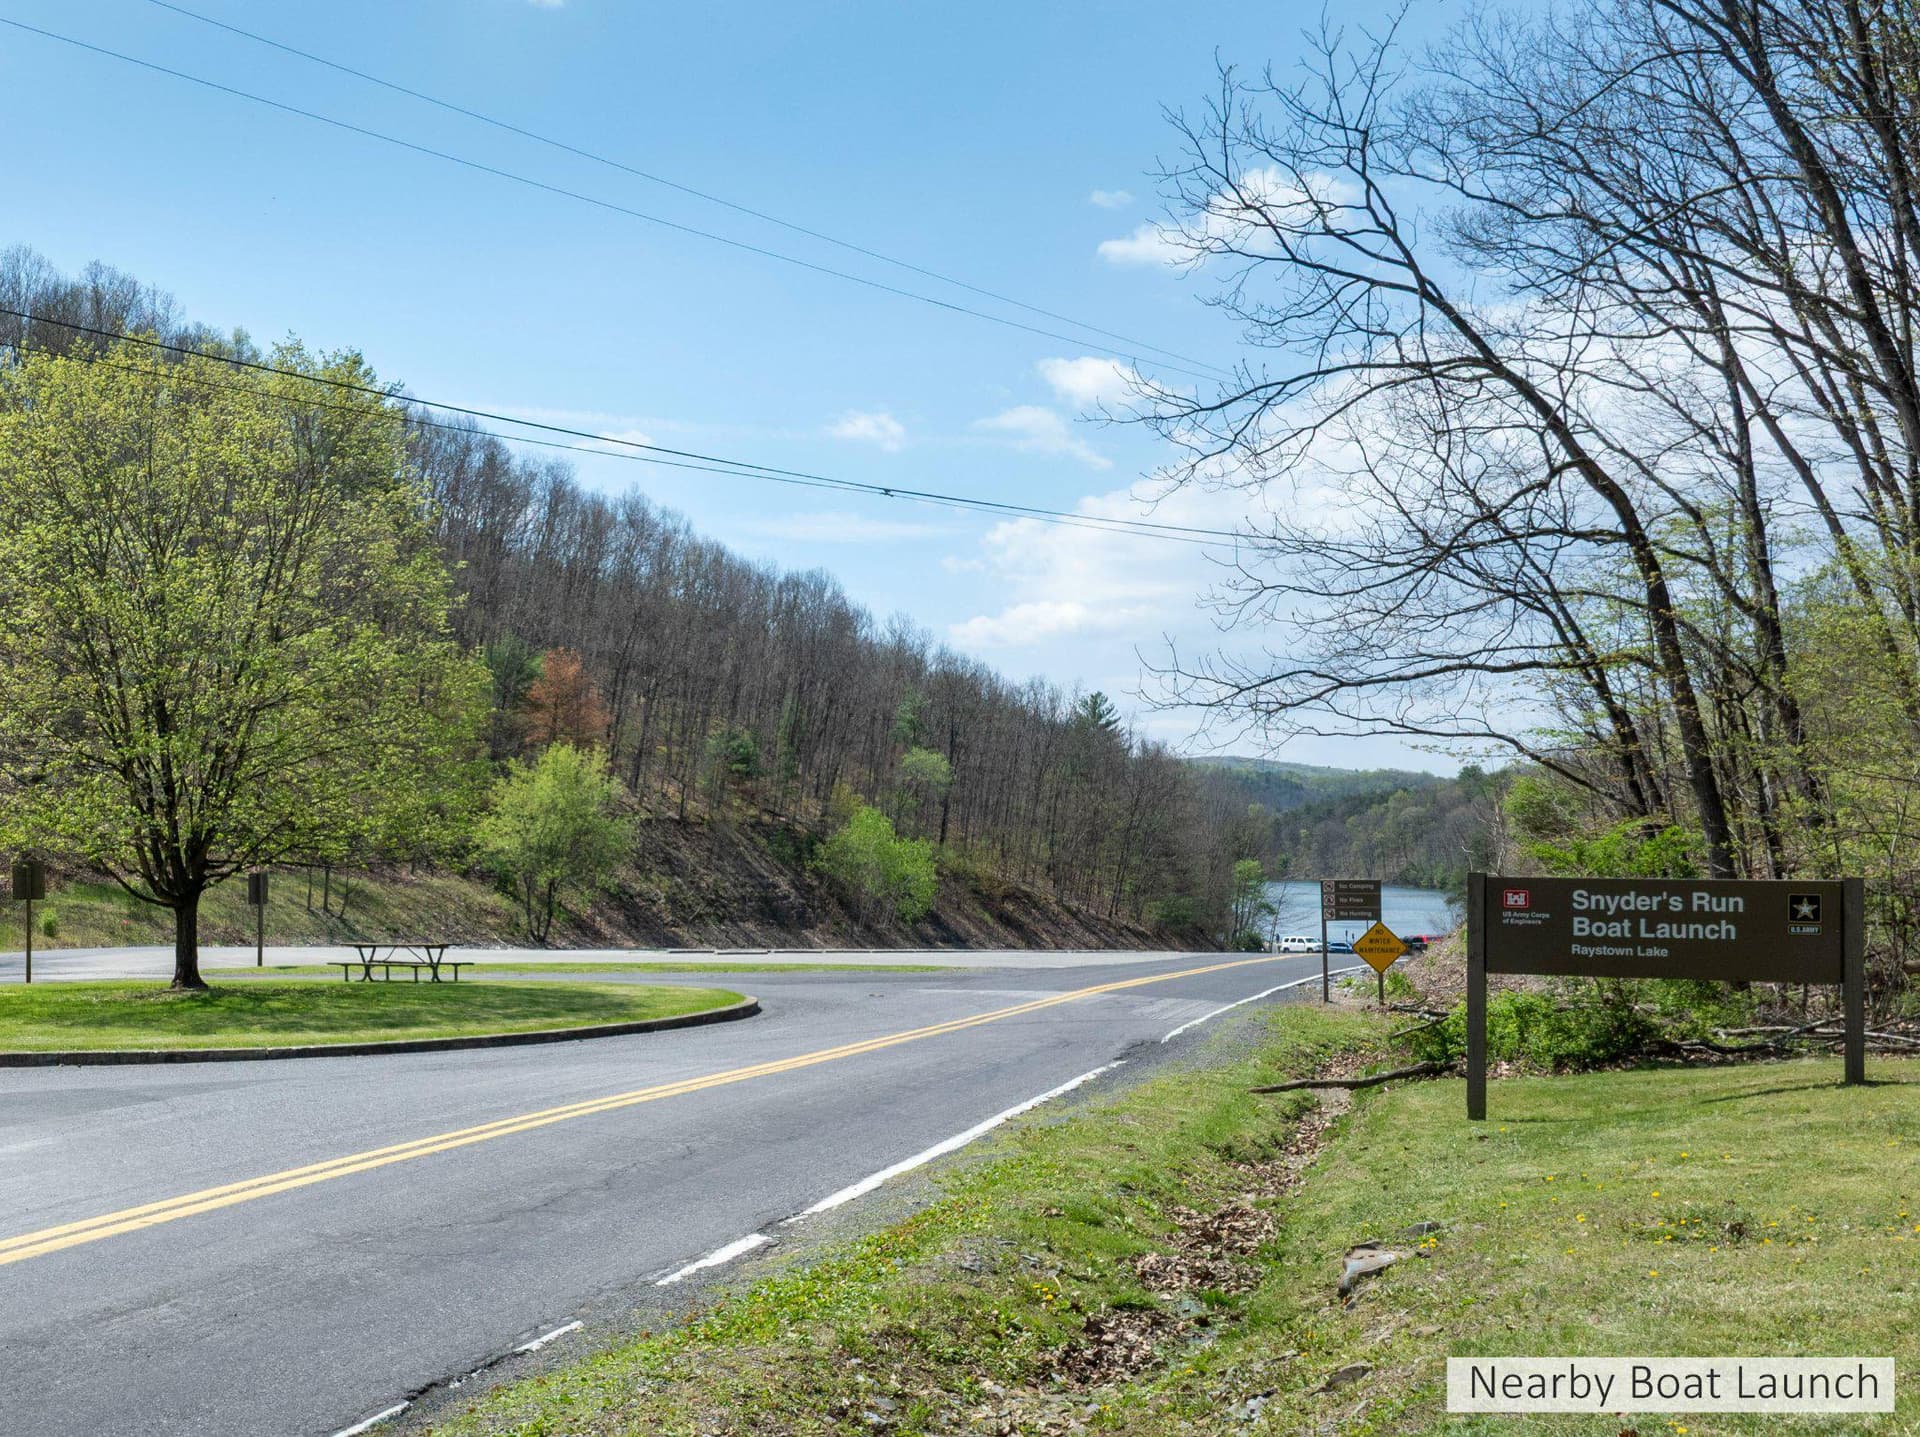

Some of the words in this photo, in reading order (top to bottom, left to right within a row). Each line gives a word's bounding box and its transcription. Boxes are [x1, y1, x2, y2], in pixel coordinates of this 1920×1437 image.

[1572, 890, 1683, 915] Snyder's
[1693, 893, 1744, 912] Run
[1573, 916, 1631, 937] Boat
[1641, 918, 1735, 940] Launch
[1571, 944, 1633, 958] Raystown
[1638, 945, 1668, 957] Lake
